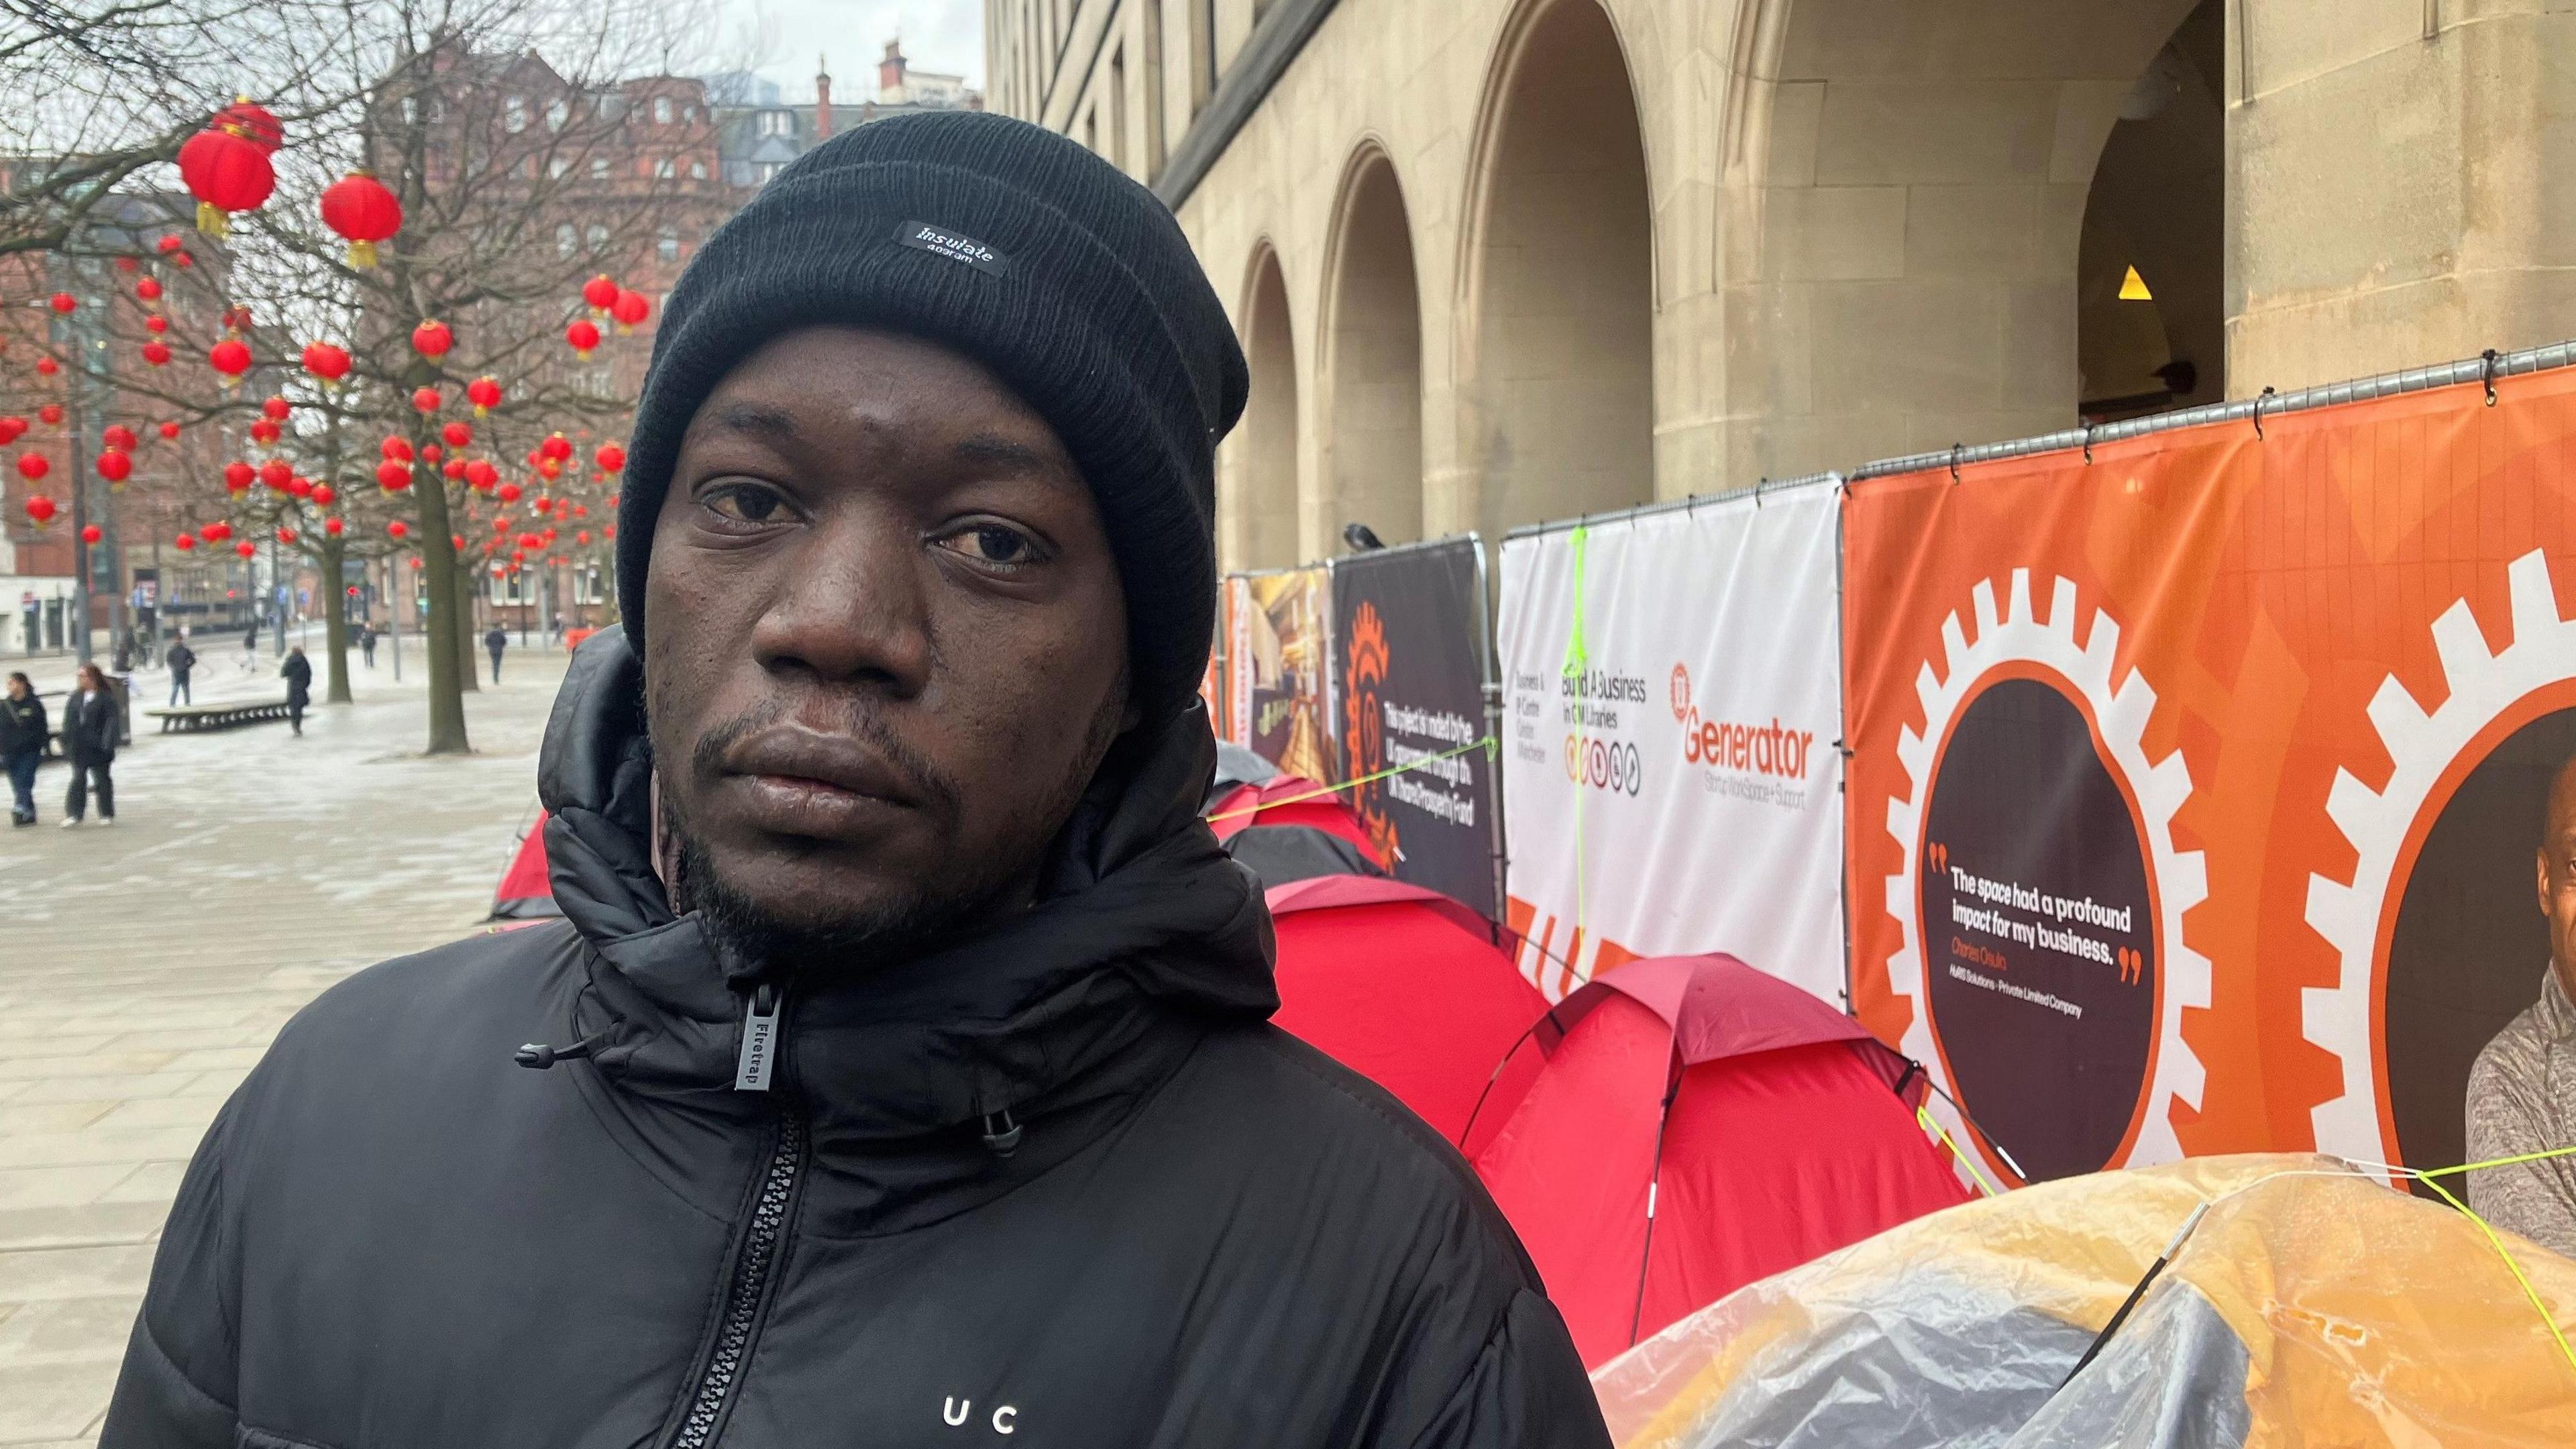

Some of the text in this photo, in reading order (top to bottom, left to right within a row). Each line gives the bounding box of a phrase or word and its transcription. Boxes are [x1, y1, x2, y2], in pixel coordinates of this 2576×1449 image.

[915, 227, 994, 262] Insulate
[1591, 669, 1597, 698] A
[1598, 669, 1646, 703] Business
[1564, 702, 1570, 722] in
[1684, 706, 1814, 780] Generator
[1951, 865, 2132, 933] The space had a profound
[1953, 898, 2114, 966] impact for my business.
[1998, 979, 2023, 1000] Private
[2024, 987, 2049, 1008] Limited
[2049, 994, 2083, 1020] Company
[745, 1024, 769, 1084] Firetrap
